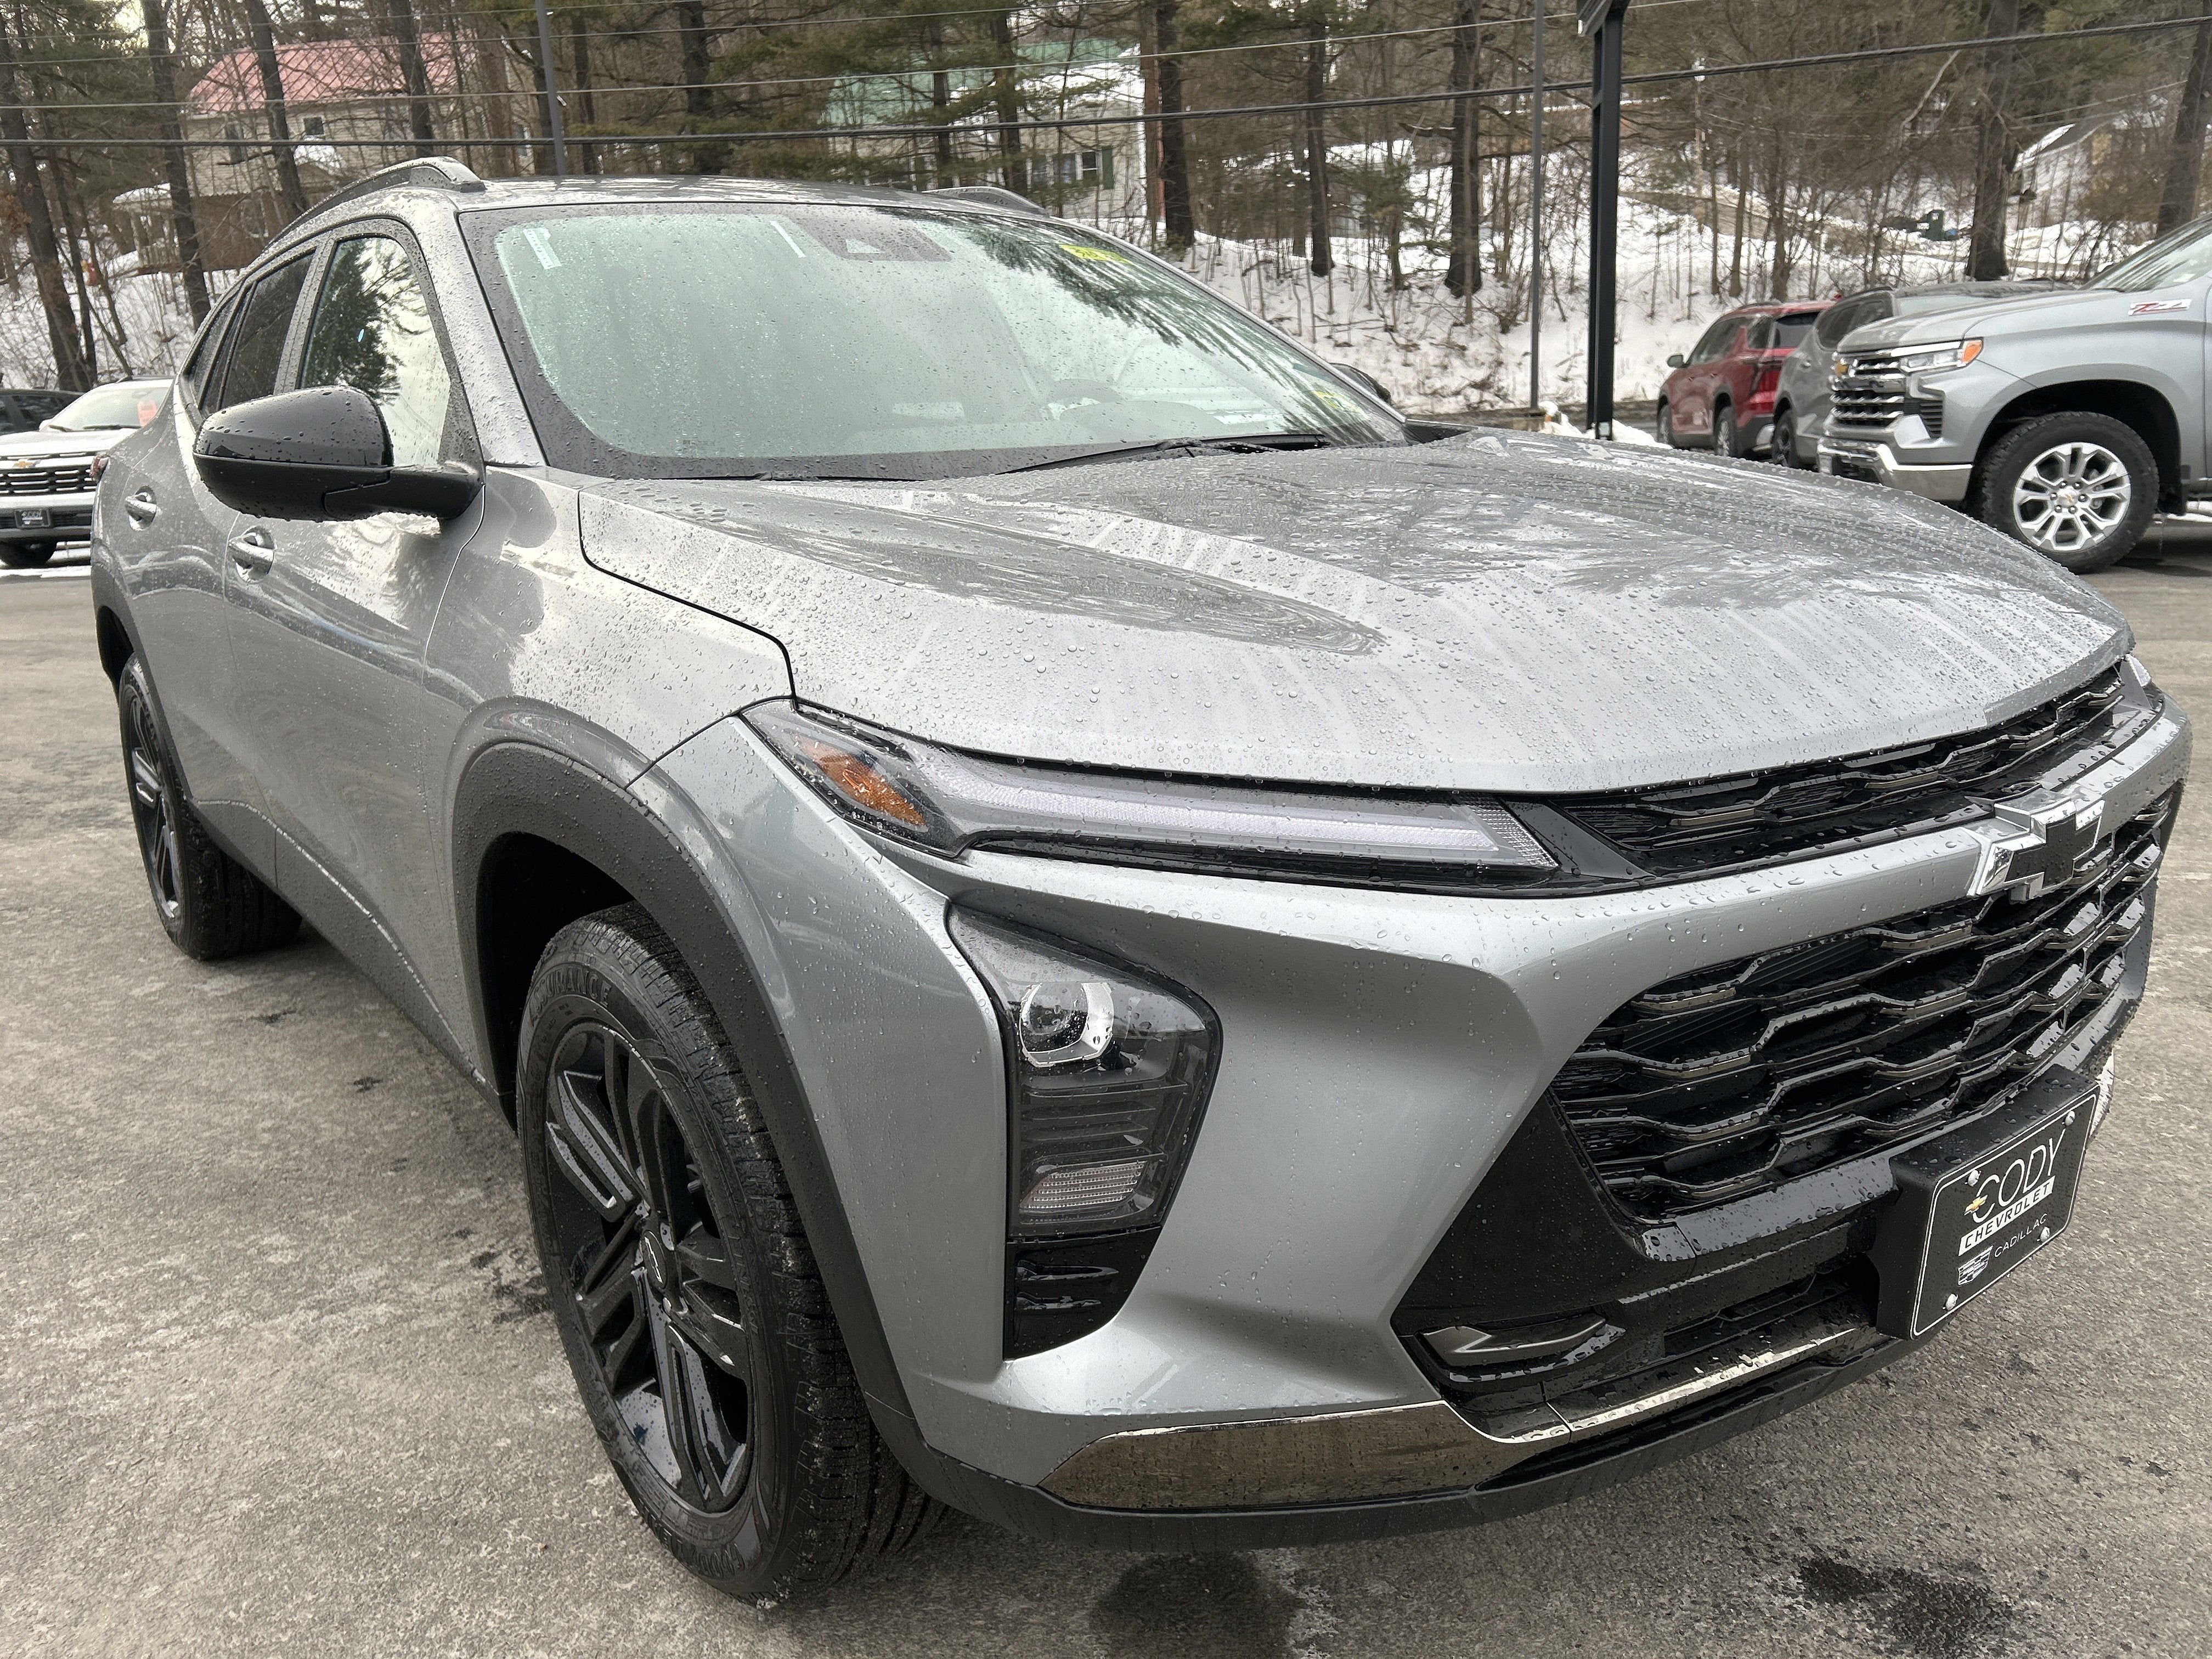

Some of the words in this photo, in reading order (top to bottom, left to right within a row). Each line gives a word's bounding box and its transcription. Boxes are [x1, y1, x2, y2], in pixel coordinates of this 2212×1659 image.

[1972, 1128, 2066, 1223] CODY
[1963, 1180, 2052, 1250] CHEVROLET
[1994, 1213, 2047, 1257] CADILLAC
